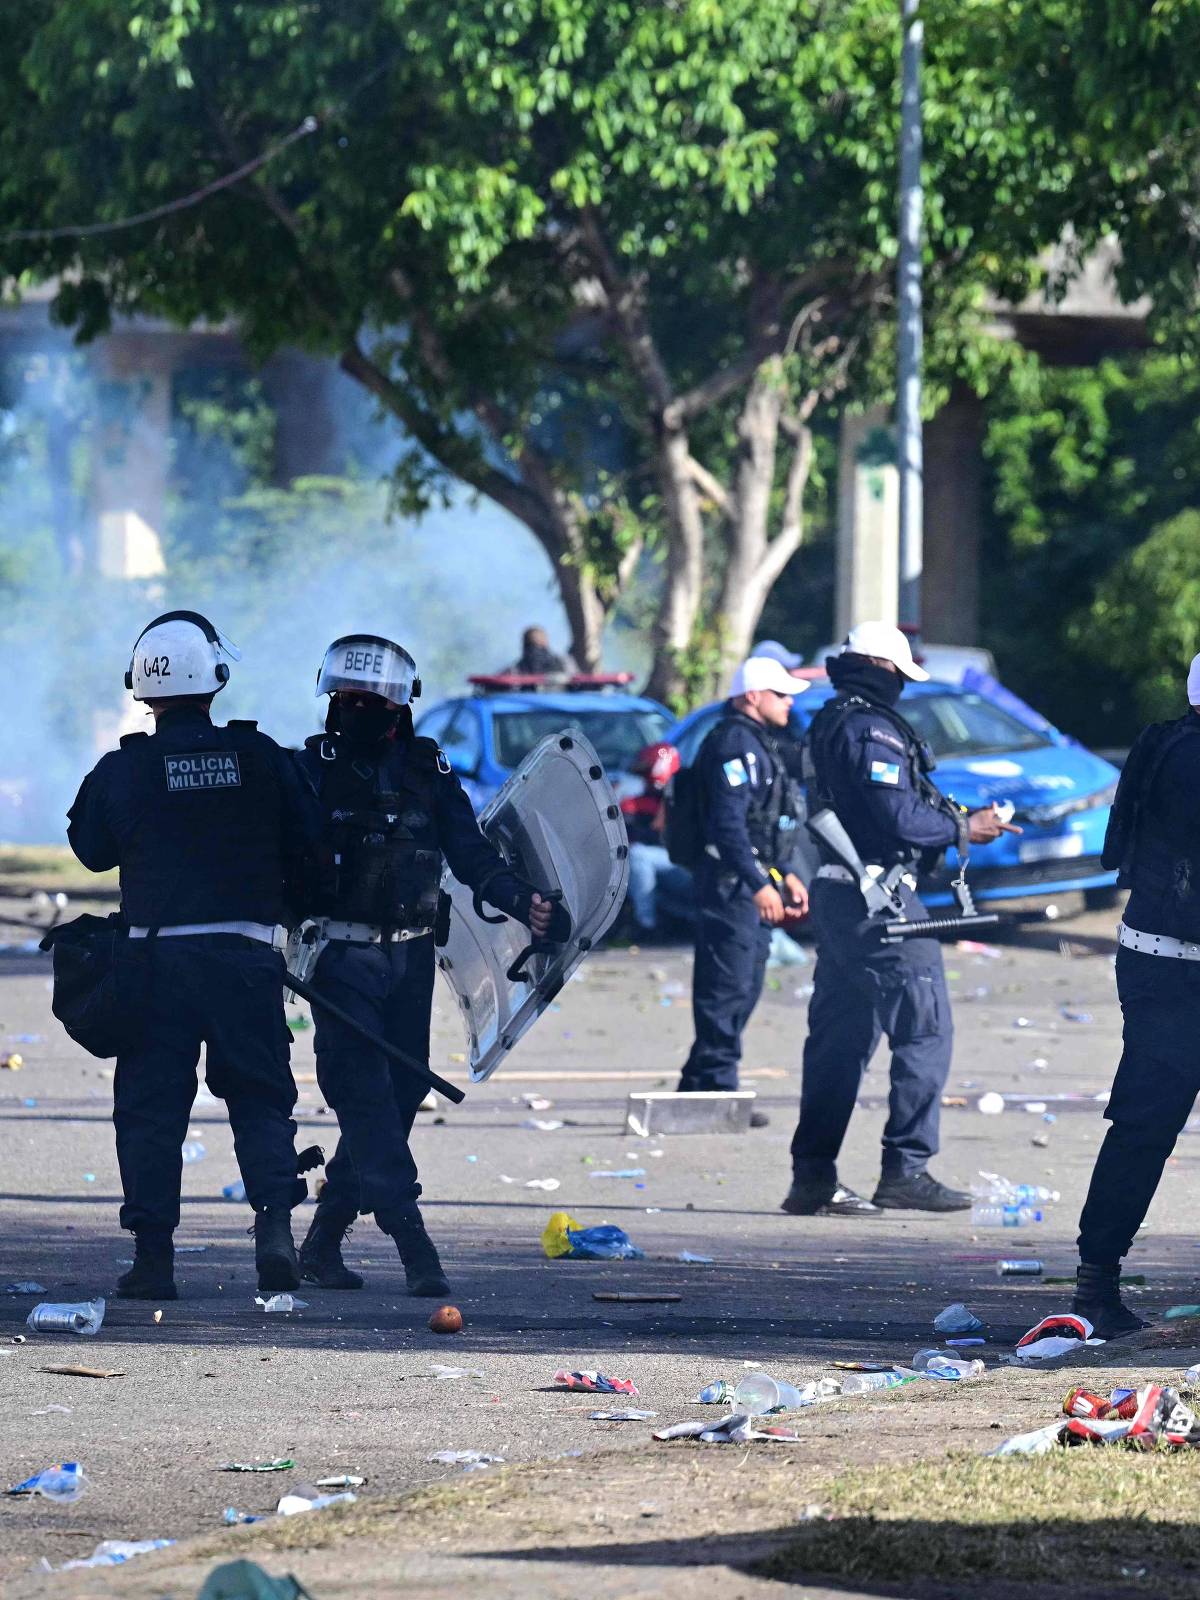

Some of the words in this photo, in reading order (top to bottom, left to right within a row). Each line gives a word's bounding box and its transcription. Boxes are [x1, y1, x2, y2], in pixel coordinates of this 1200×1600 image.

[345, 651, 382, 674] BEPE
[167, 755, 236, 774] POLÍCIA
[169, 771, 238, 789] MILITAR
